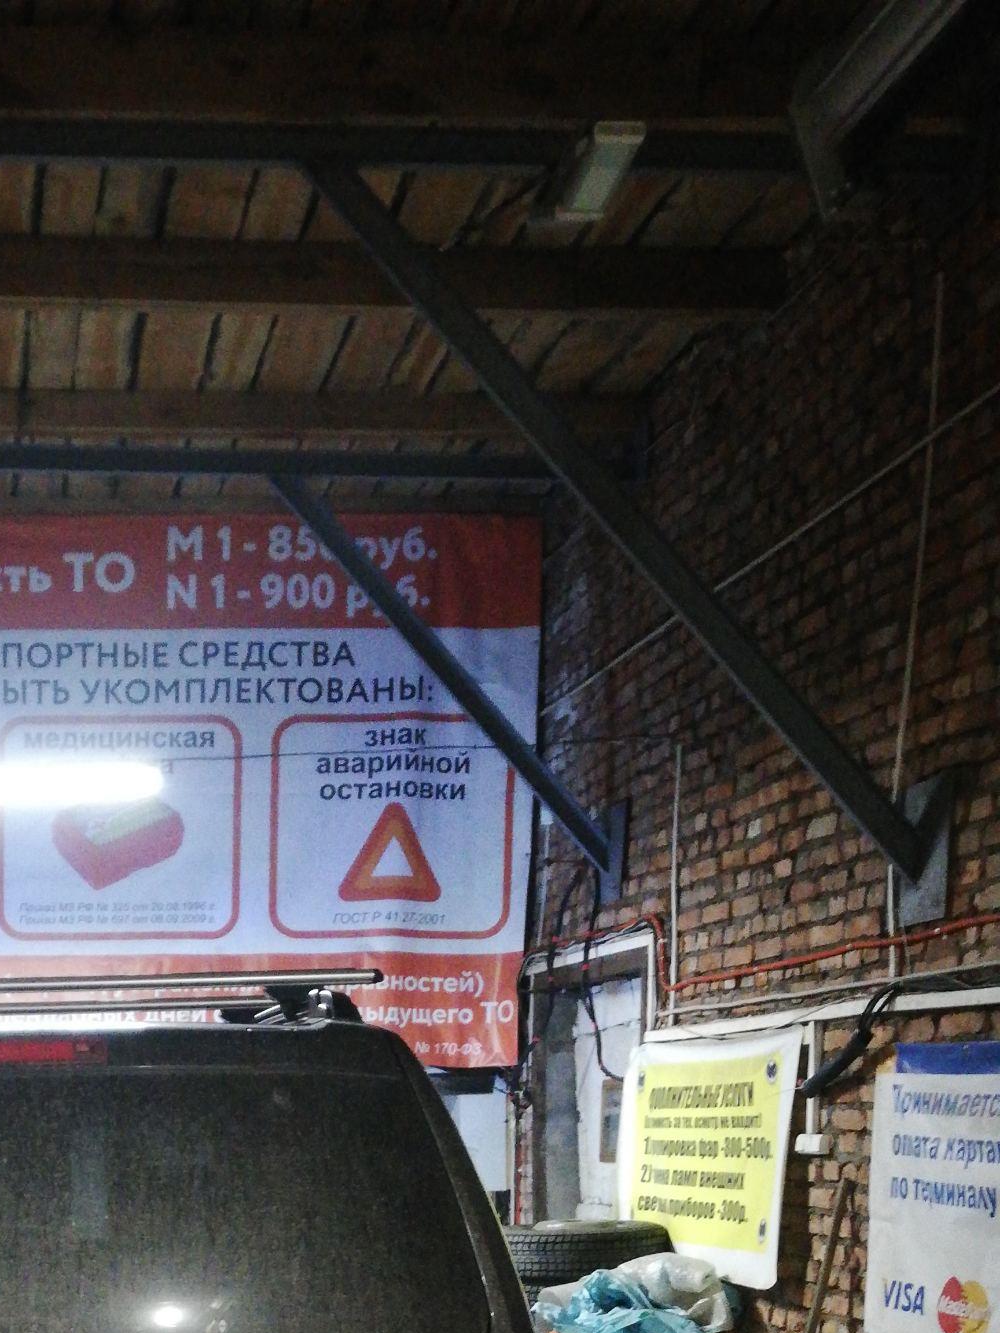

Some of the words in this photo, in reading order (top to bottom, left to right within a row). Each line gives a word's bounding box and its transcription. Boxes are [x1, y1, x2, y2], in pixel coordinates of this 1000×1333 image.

[63, 551, 135, 592] ТО
[260, 573, 334, 609] 900
[346, 576, 431, 618] рб.
[178, 641, 355, 672] СРЕДСТВА
[81, 675, 433, 705] УКОМПЛЕКТОВАНЫ:
[24, 729, 216, 752] медицинская
[364, 725, 427, 746] знак
[316, 751, 470, 777] аварийной
[320, 779, 466, 801] остановки
[332, 911, 369, 924] ГОСТ
[480, 1000, 515, 1024] ТО
[944, 1137, 1000, 1169] карта
[890, 1177, 908, 1200] по
[884, 1280, 926, 1315] VISA
